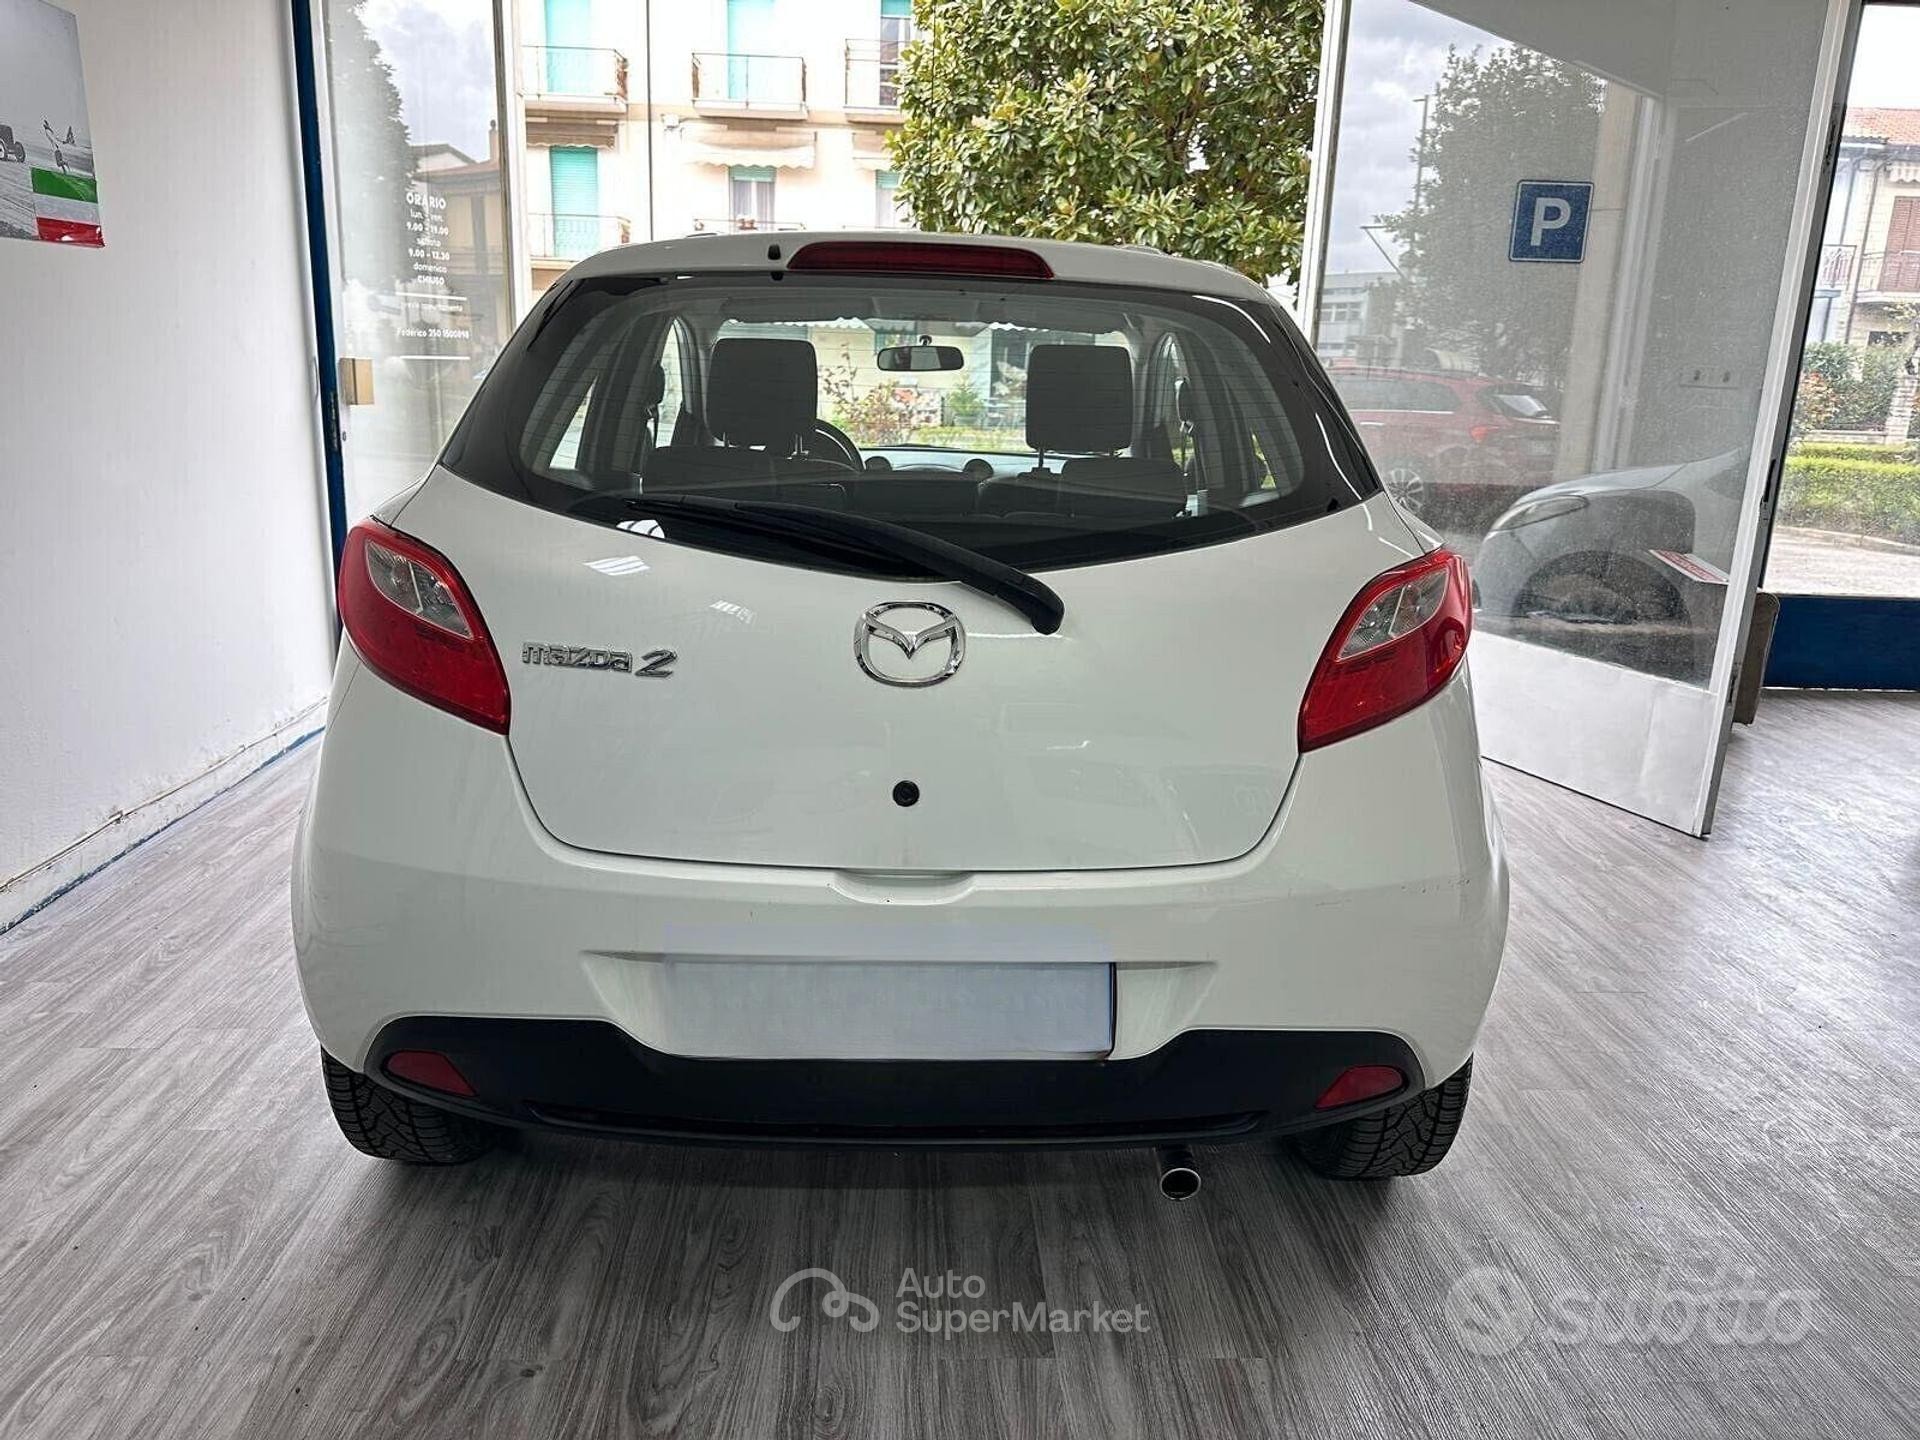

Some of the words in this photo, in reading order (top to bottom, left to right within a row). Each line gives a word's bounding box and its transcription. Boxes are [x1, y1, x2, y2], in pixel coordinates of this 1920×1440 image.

[406, 192, 447, 210] ORARIO
[406, 222, 424, 232] 9.00
[1530, 197, 1571, 247] P
[408, 248, 425, 258] 9.00
